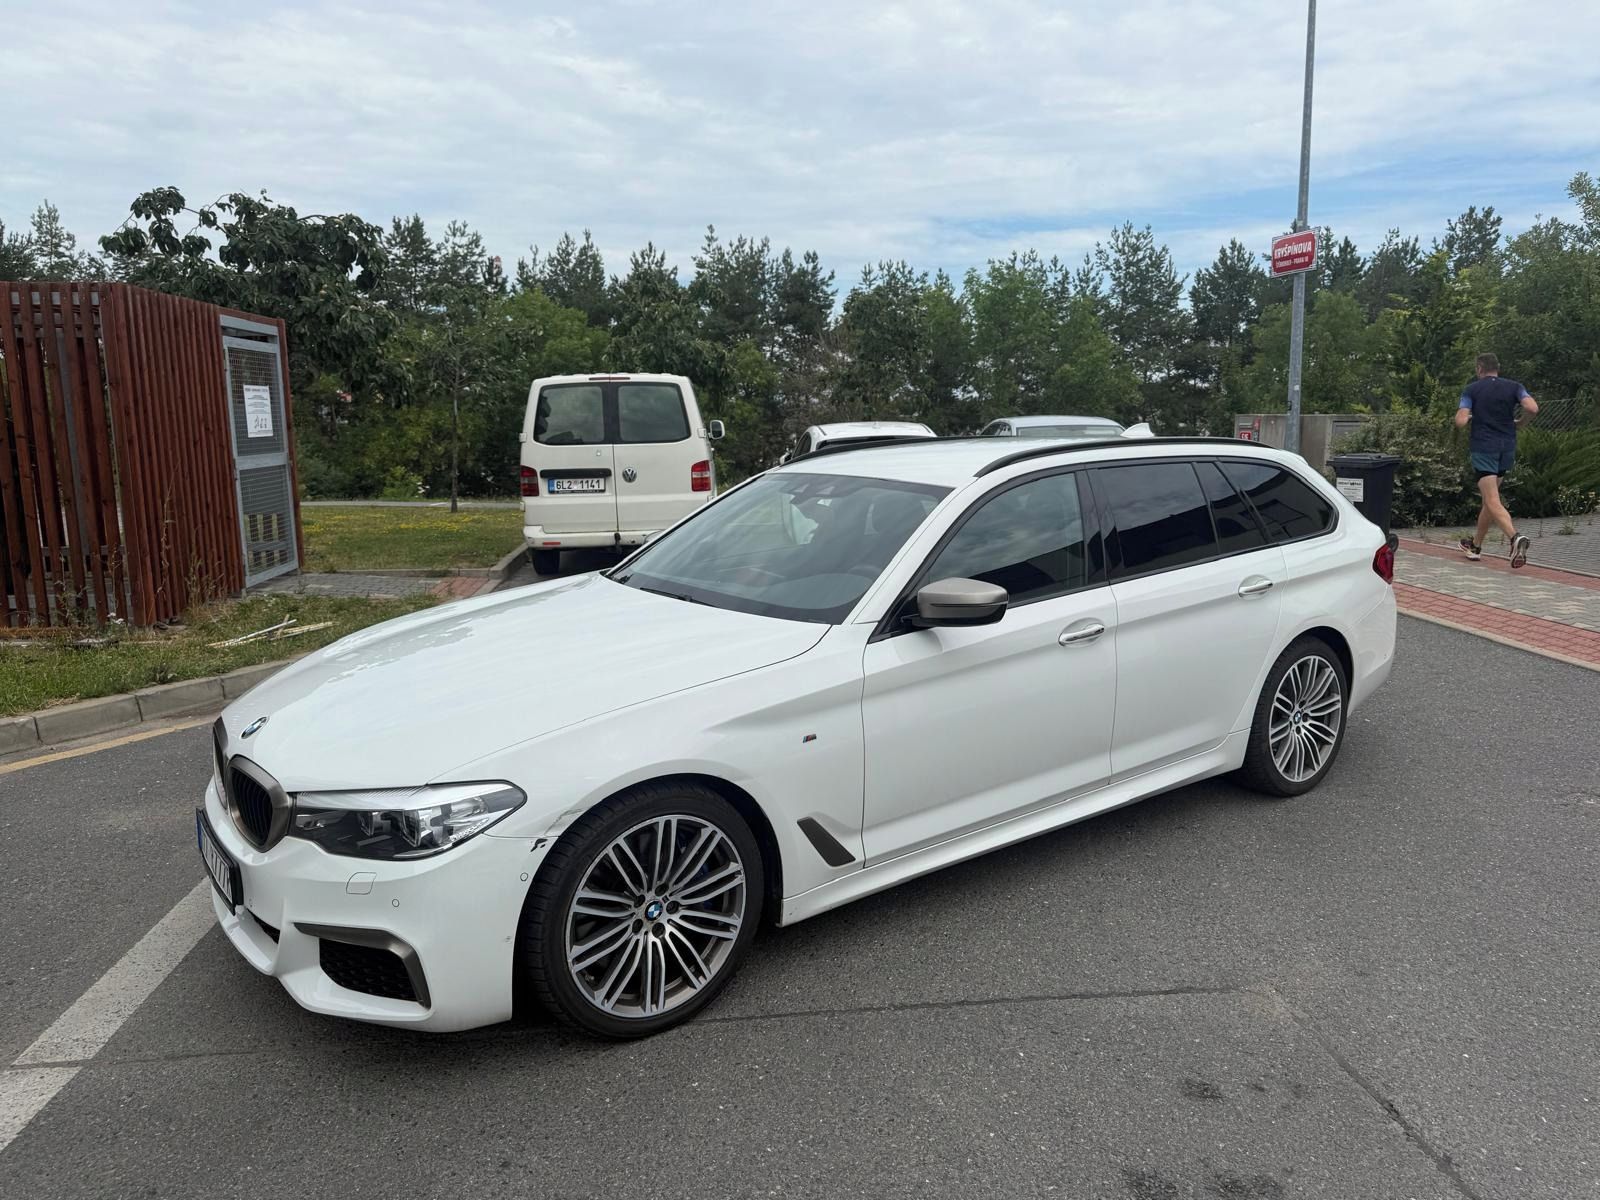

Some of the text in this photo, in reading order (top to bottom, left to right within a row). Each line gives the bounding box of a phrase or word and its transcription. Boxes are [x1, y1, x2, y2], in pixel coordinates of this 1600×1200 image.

[1274, 241, 1312, 259] KRYŠPÍNOVA
[556, 479, 600, 489] 6L2 1141
